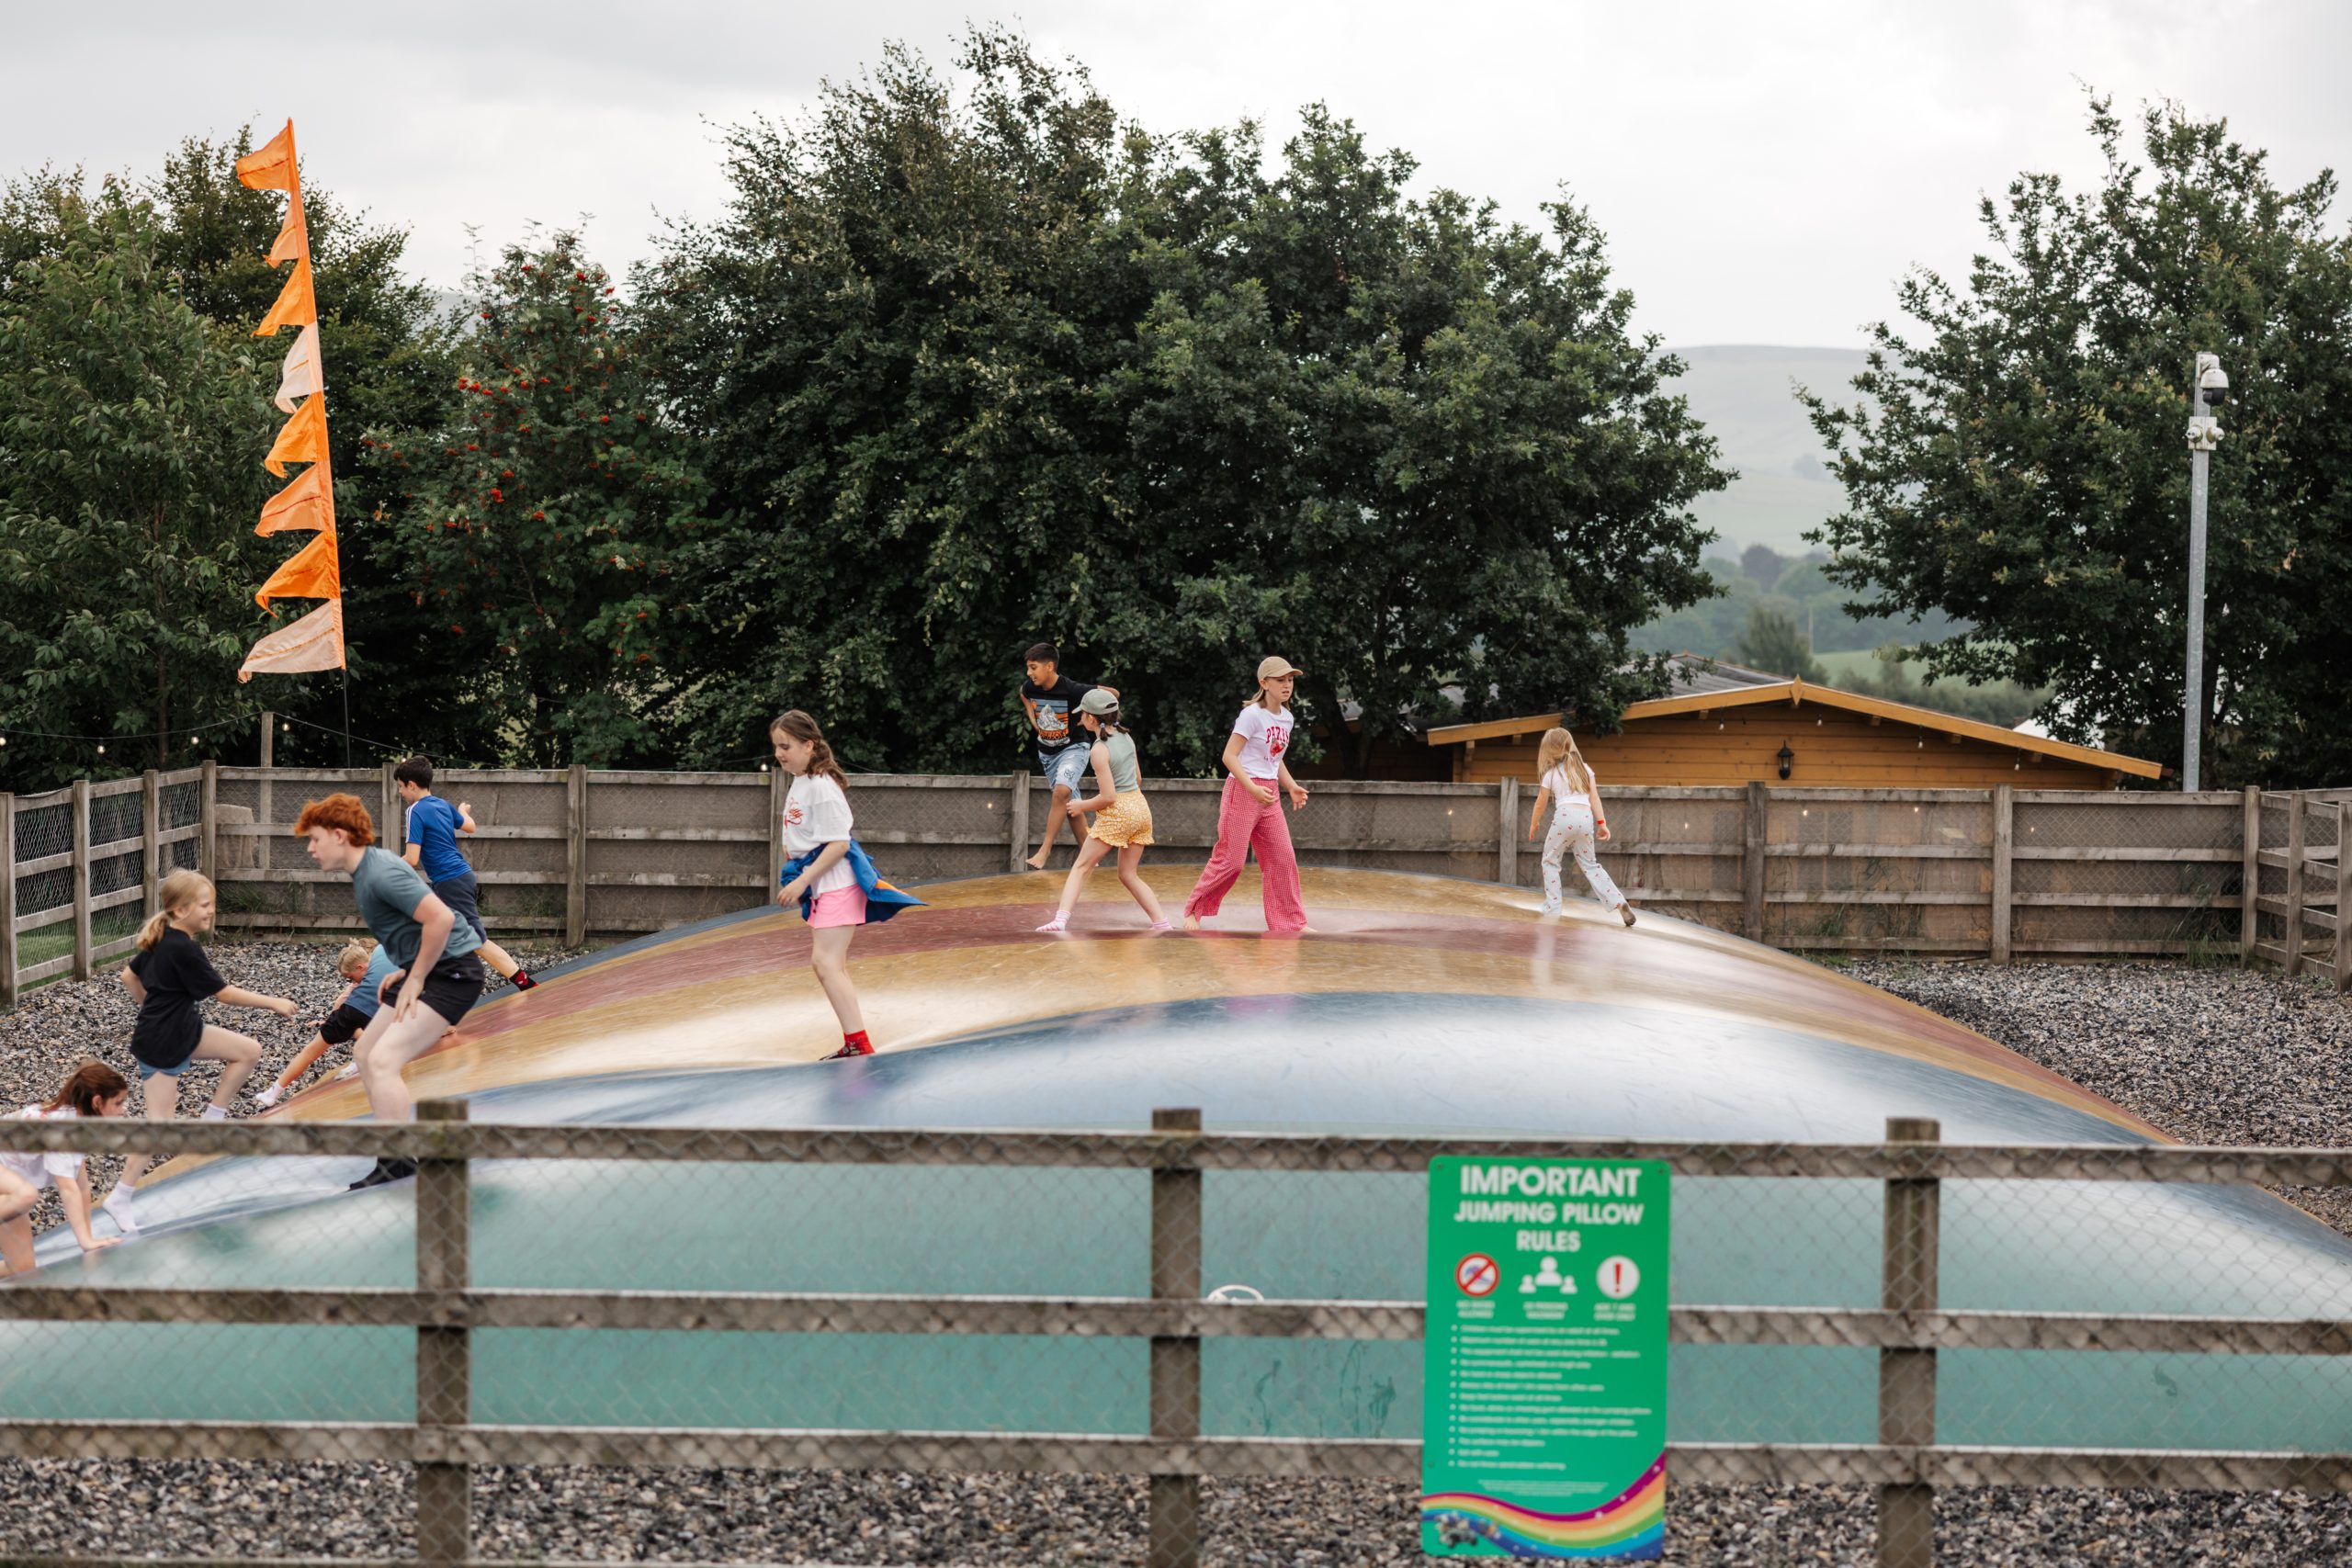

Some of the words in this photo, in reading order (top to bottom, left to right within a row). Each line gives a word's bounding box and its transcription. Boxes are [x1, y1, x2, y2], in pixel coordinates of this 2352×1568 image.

[1461, 1166, 1642, 1197] IMPORTANT
[1454, 1201, 1557, 1224] JUMPING
[1563, 1202, 1645, 1224] PILLOW
[1516, 1229, 1581, 1252] RULES
